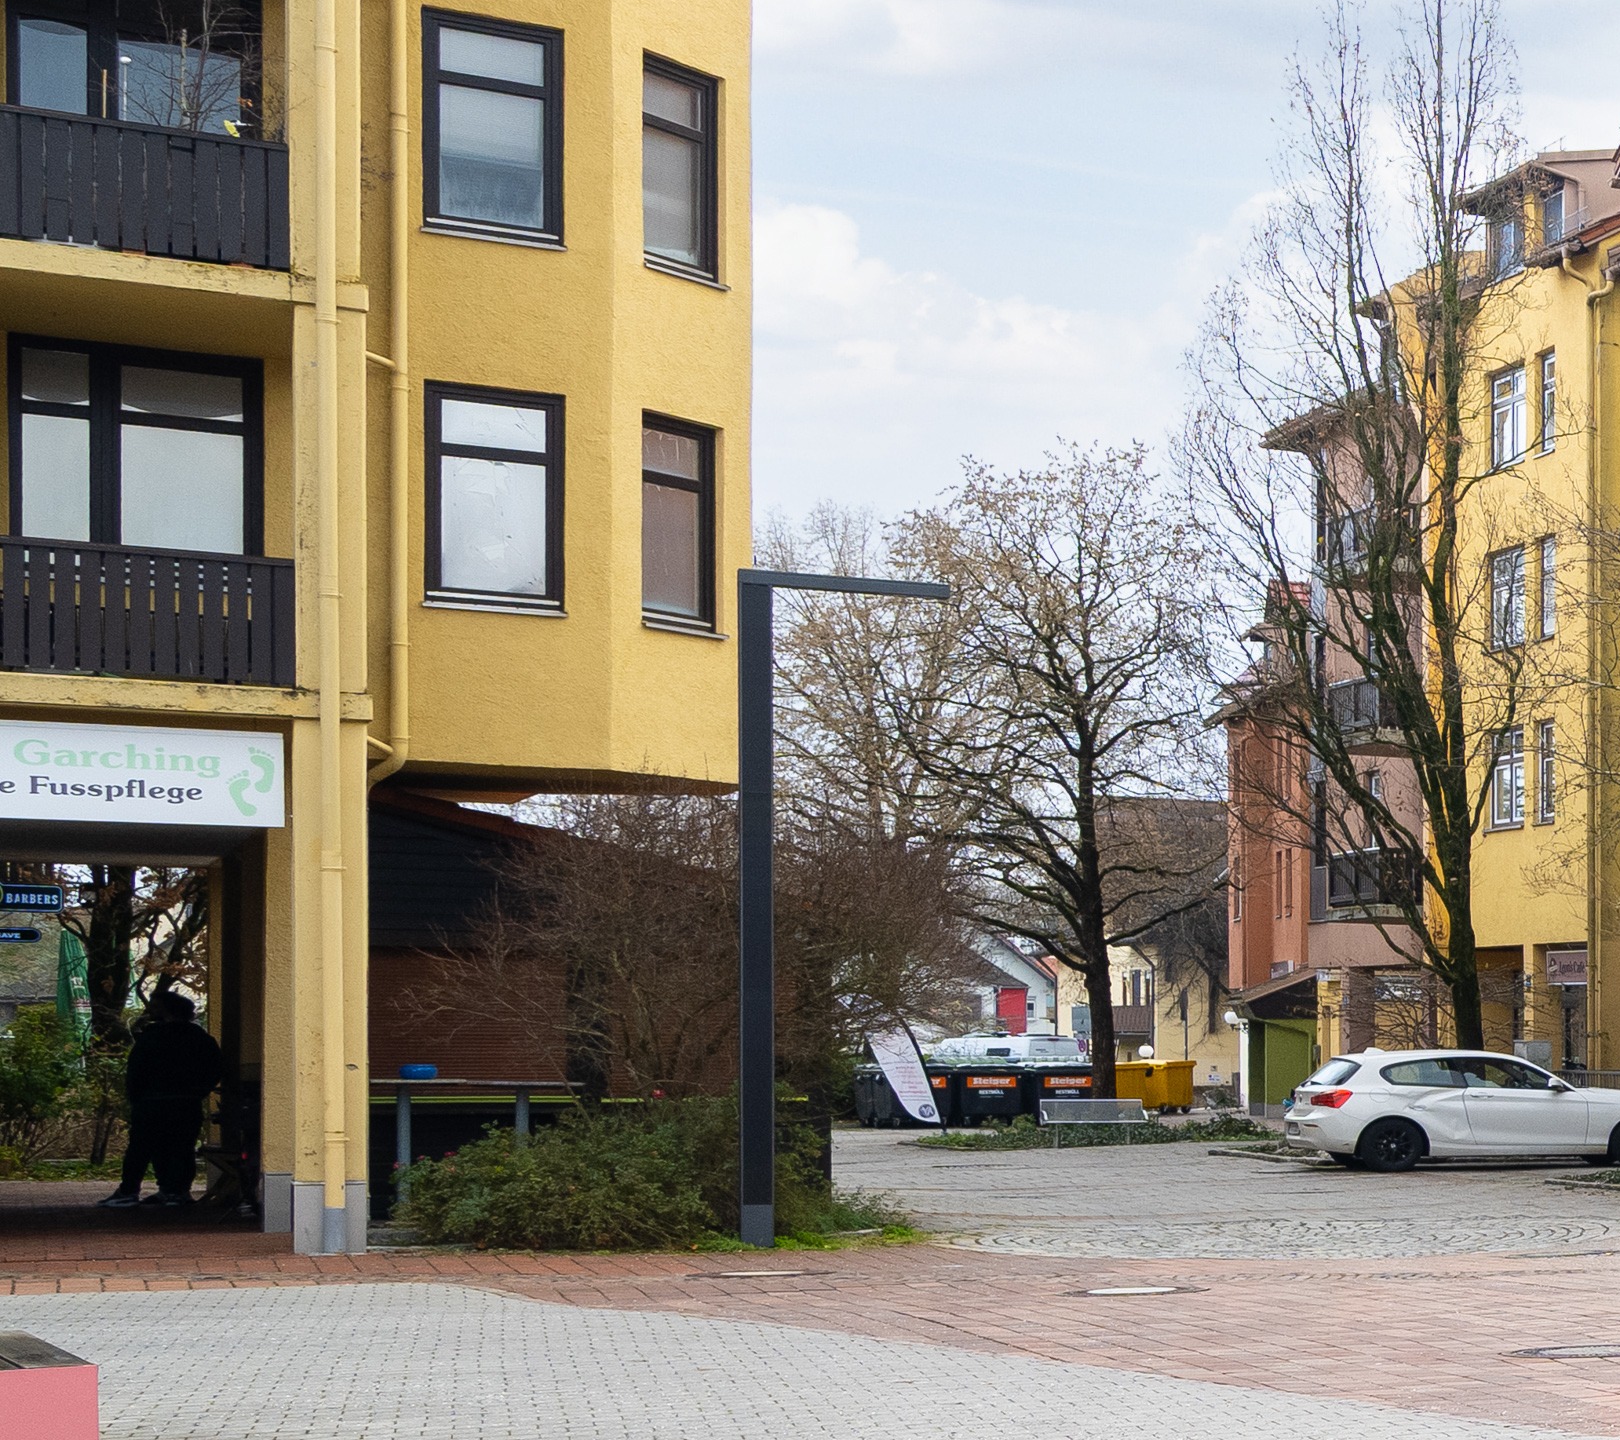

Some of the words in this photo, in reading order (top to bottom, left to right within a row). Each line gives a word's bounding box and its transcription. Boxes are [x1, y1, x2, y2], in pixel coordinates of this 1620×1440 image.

[13, 738, 221, 778] Garching
[29, 775, 203, 804] Fusspflege
[6, 893, 58, 905] BARBERS
